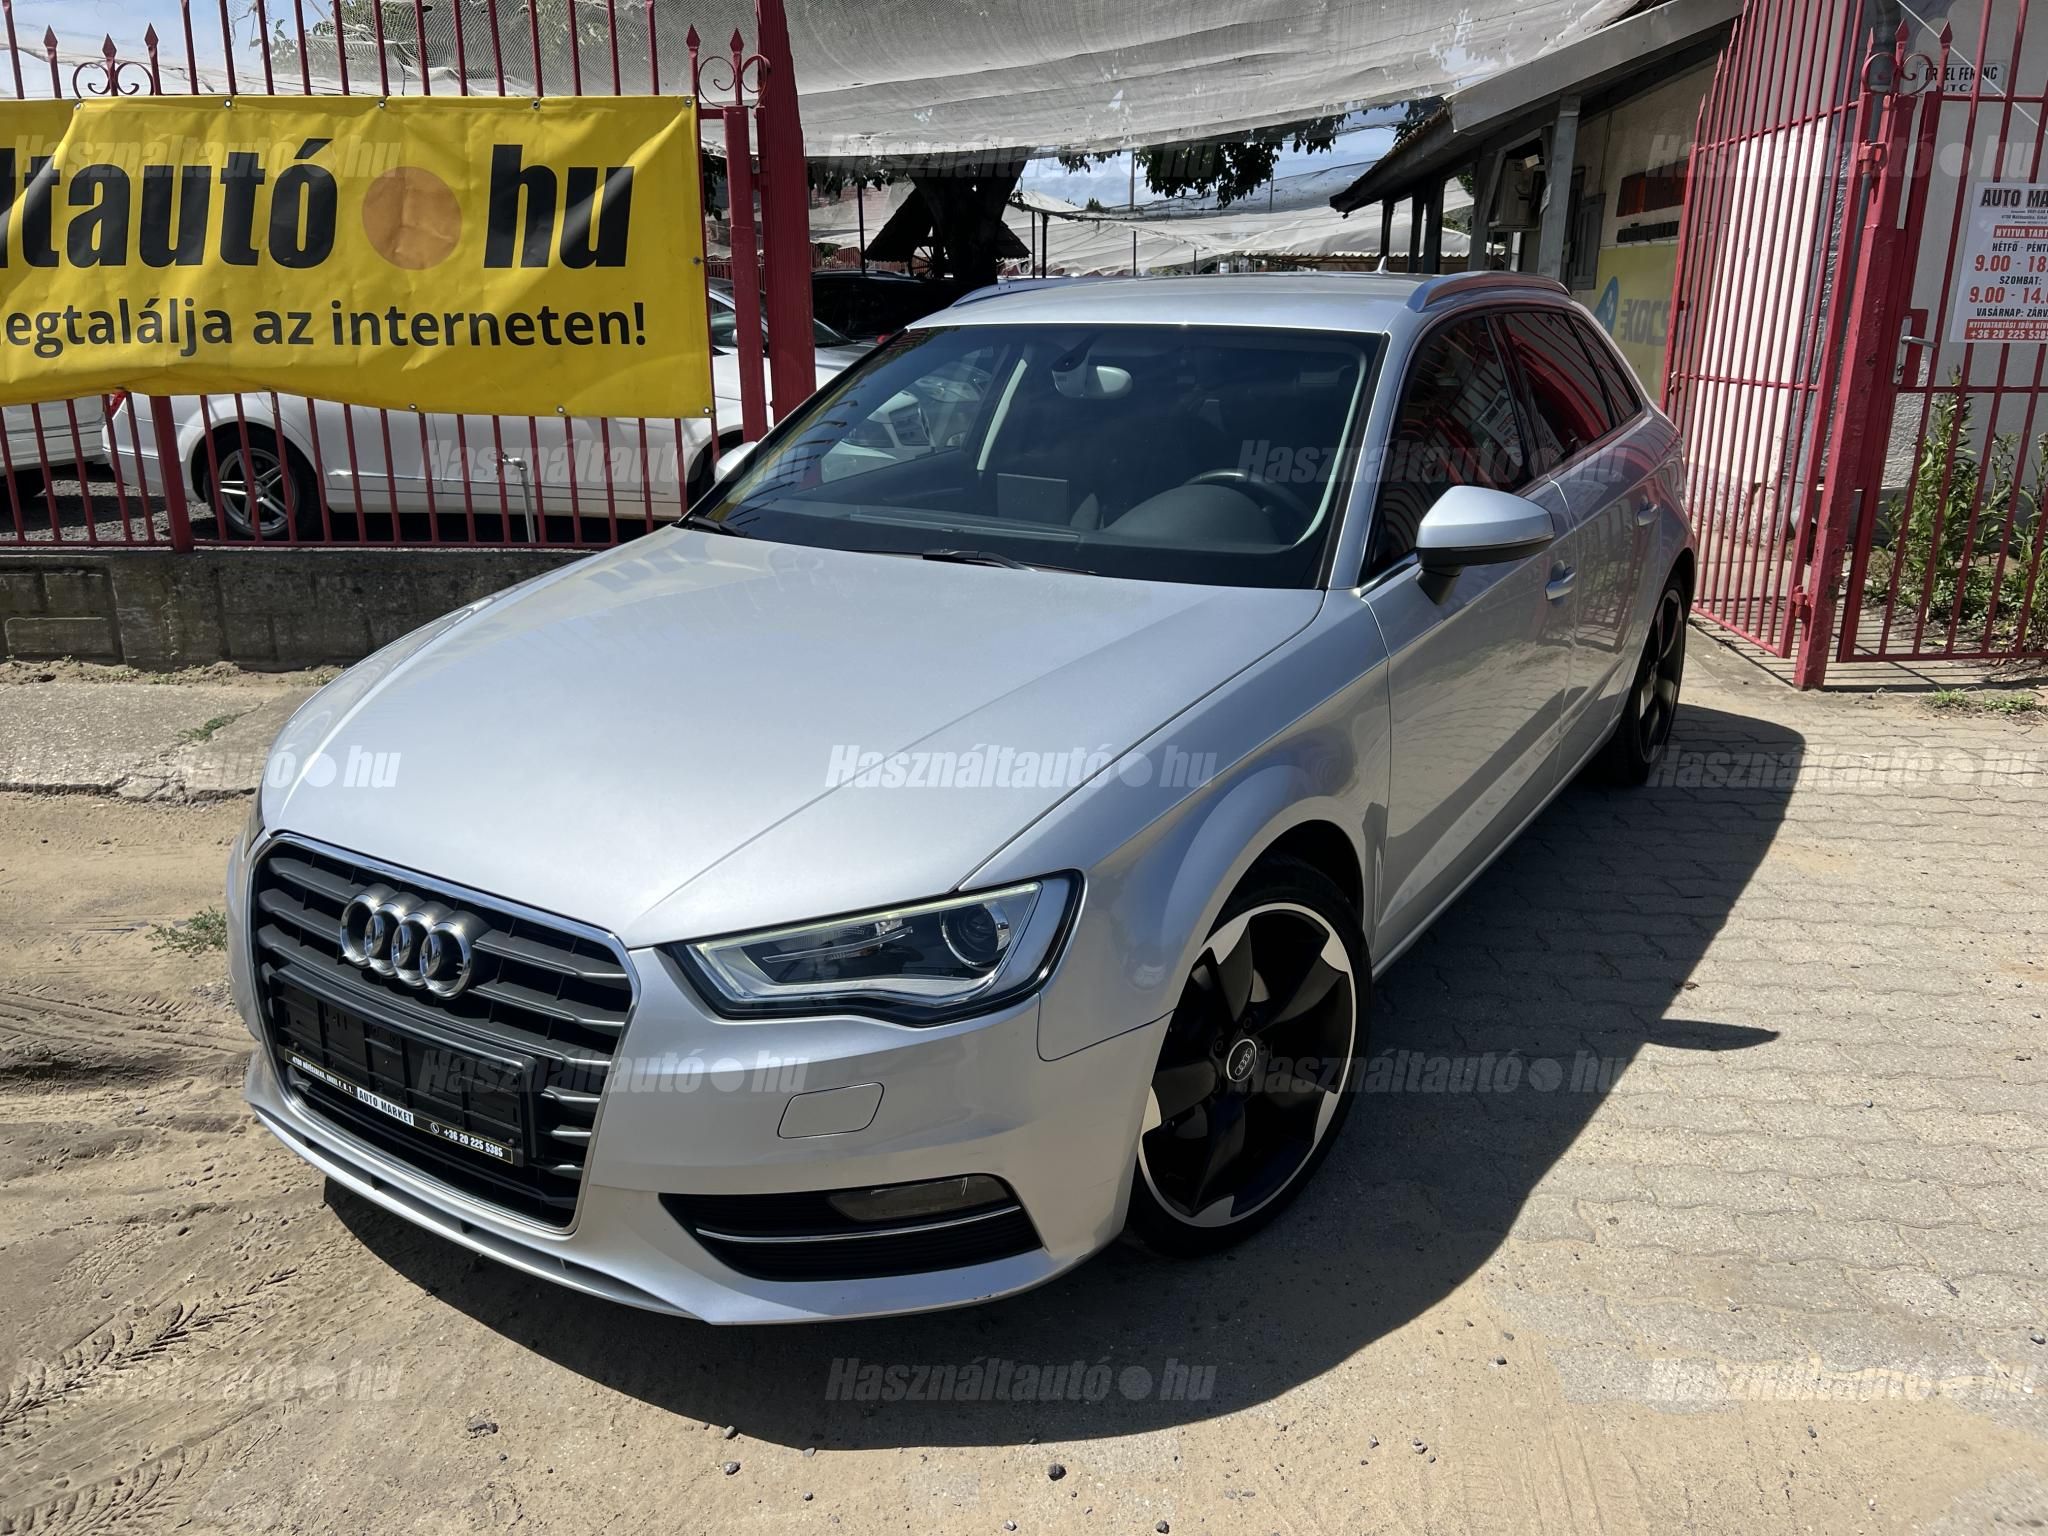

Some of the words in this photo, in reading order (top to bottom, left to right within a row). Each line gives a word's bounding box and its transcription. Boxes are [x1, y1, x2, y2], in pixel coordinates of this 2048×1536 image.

[1926, 67, 1955, 80] EREL
[1959, 67, 1998, 80] FERNC
[1980, 188, 2021, 207] AUTO
[485, 144, 635, 269] hu
[1995, 228, 2026, 238] NYITVA
[1992, 240, 2020, 252] HÉTFŐ
[1974, 254, 2011, 272] 9.00
[1999, 275, 2043, 286] SZOMBAT:
[1969, 286, 2006, 304] 9.00
[2023, 287, 2048, 304] 14.
[1976, 306, 2025, 318] VASÁRNAP:
[2027, 306, 2048, 318] ZÁRV
[6, 298, 233, 359] egtalálja
[252, 310, 314, 345] az
[331, 300, 647, 346] interneten!
[1970, 329, 1990, 339] +36
[1992, 329, 2005, 339] 20
[2007, 329, 2026, 339] 225
[359, 1090, 378, 1107] AUTO
[381, 1102, 412, 1125] MARKET
[443, 1128, 458, 1141] +36
[459, 1133, 469, 1145] 20
[470, 1137, 483, 1150] 225
[485, 1142, 503, 1157] 5385
